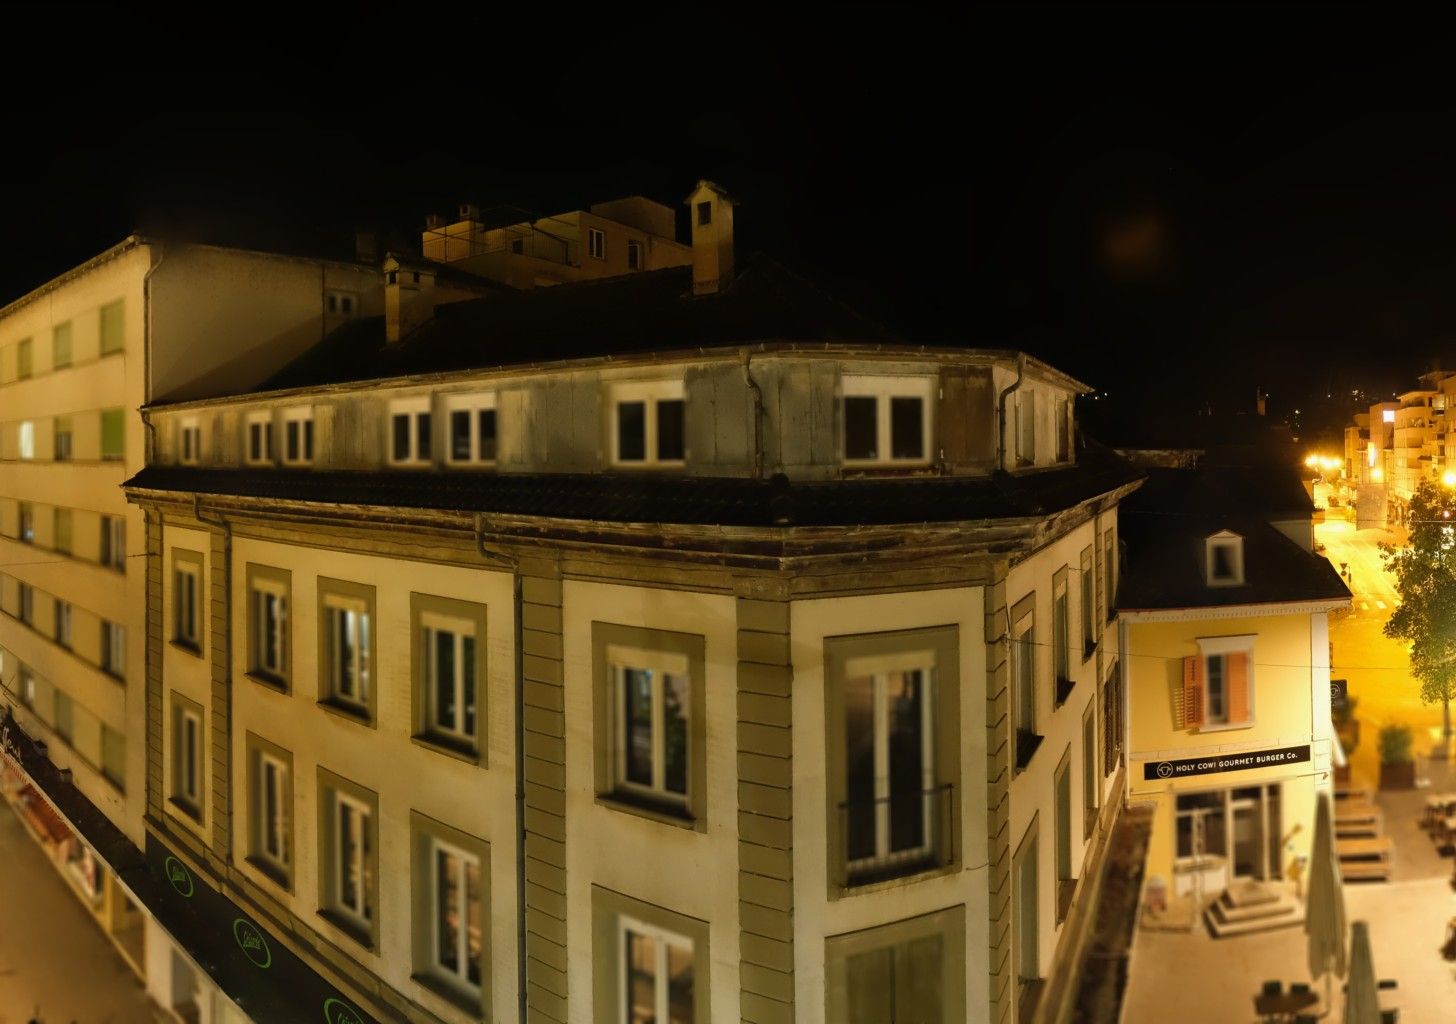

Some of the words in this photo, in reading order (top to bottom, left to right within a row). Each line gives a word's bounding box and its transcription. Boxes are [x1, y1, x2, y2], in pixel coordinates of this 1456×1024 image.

[1176, 764, 1195, 772] HOLY
[1197, 762, 1217, 770] COW!
[1219, 757, 1254, 768] GOURMET
[1256, 754, 1285, 763] BURGER
